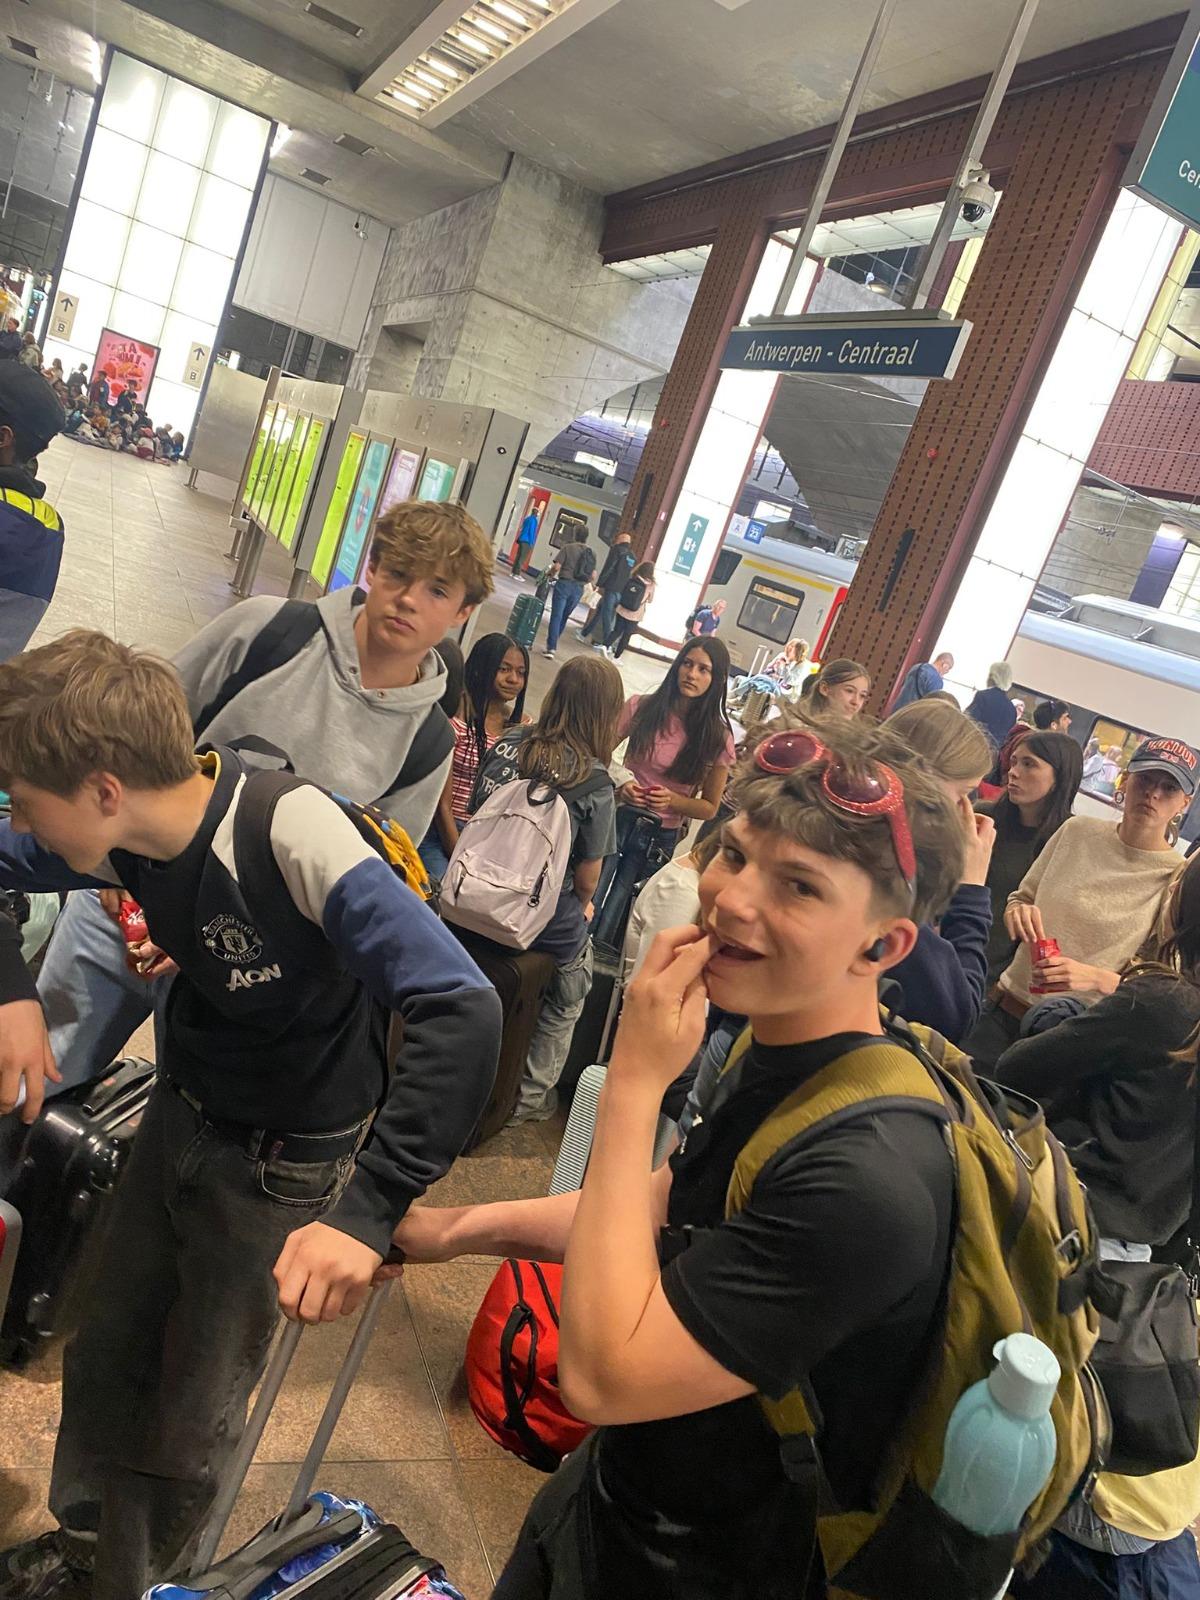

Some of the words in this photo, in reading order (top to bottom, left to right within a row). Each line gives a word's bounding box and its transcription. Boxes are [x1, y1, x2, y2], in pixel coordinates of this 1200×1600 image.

[57, 323, 66, 332] B
[744, 340, 822, 367] Antwerpen
[838, 339, 919, 365] Centraal
[189, 371, 197, 380] B
[495, 743, 519, 760] OU
[224, 951, 257, 961] UNITED
